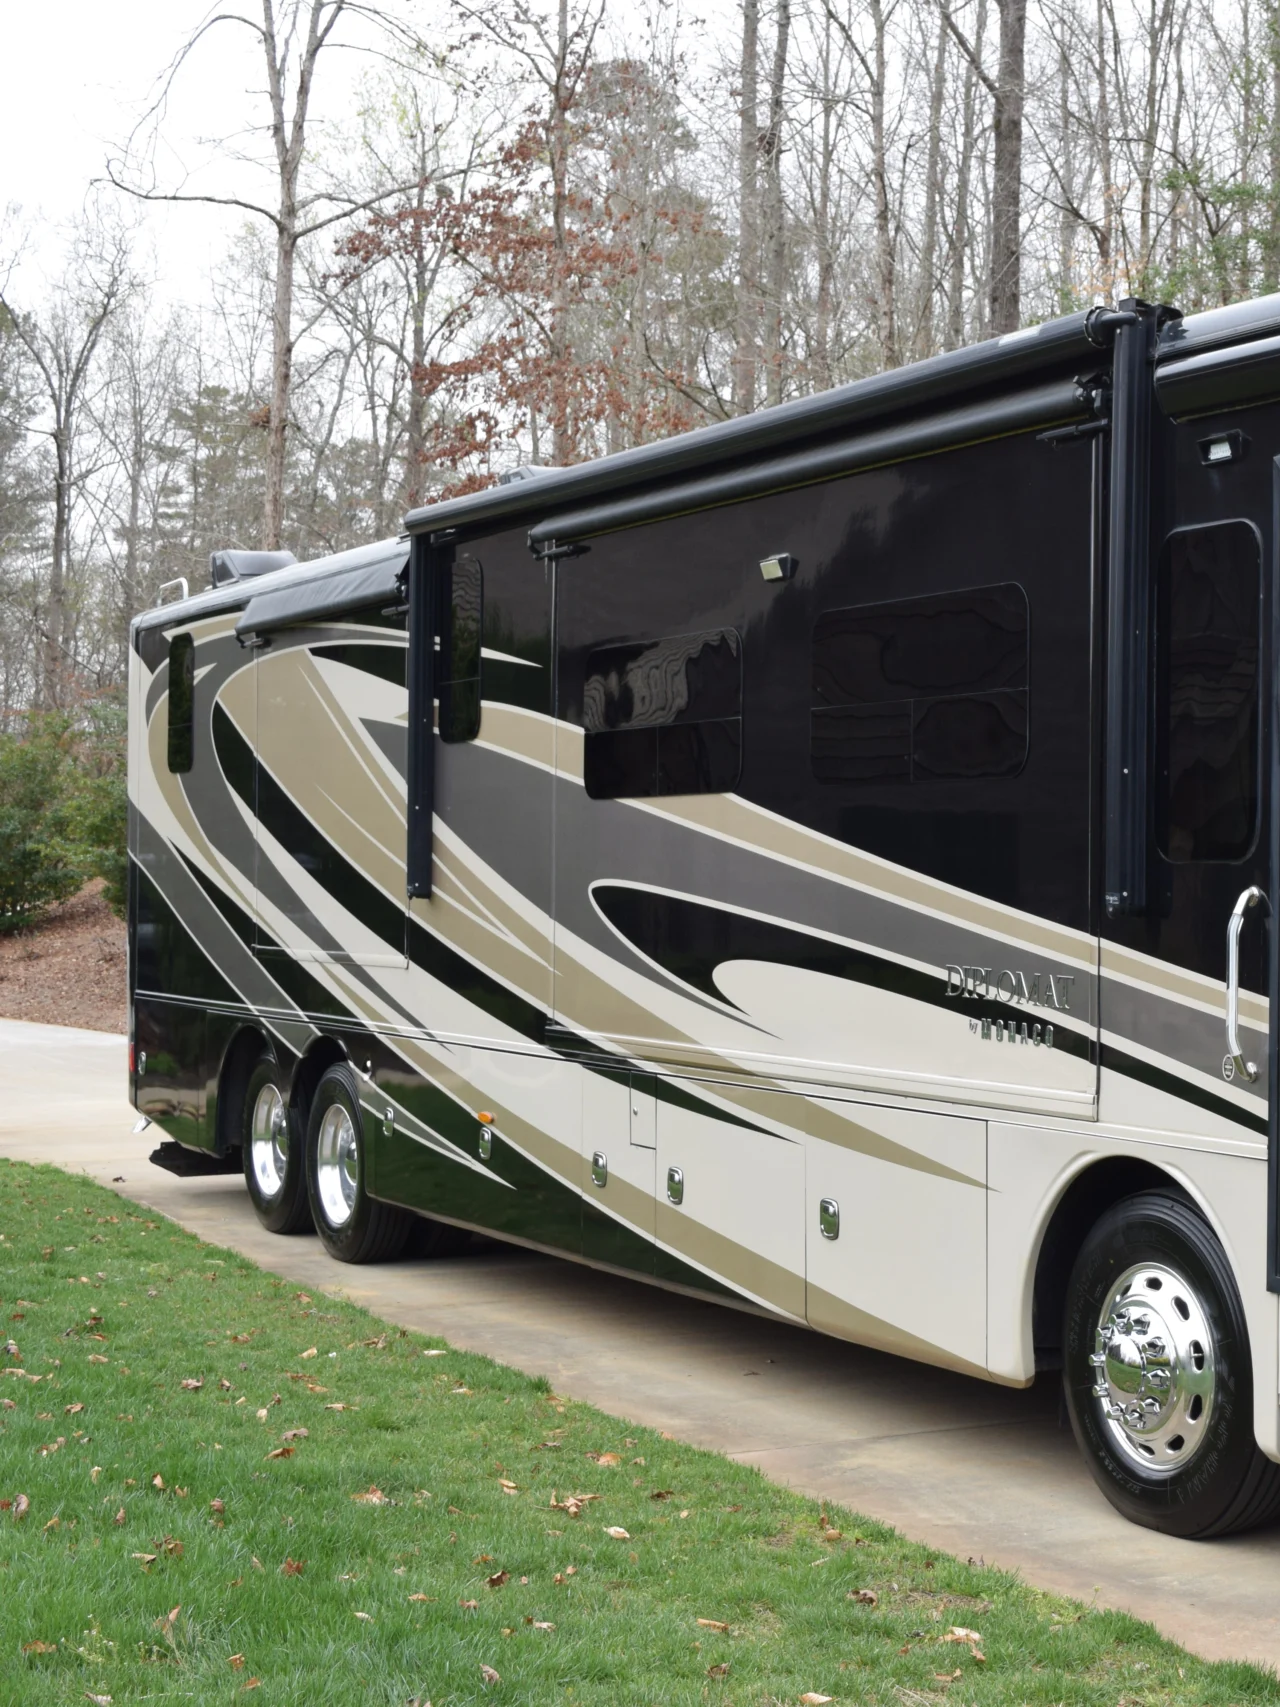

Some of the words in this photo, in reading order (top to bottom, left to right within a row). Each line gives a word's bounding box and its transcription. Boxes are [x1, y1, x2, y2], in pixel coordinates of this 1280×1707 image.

[945, 964, 1075, 1009] DIPLOMAT
[969, 1019, 979, 1034] by
[981, 1018, 1054, 1049] MONACO
